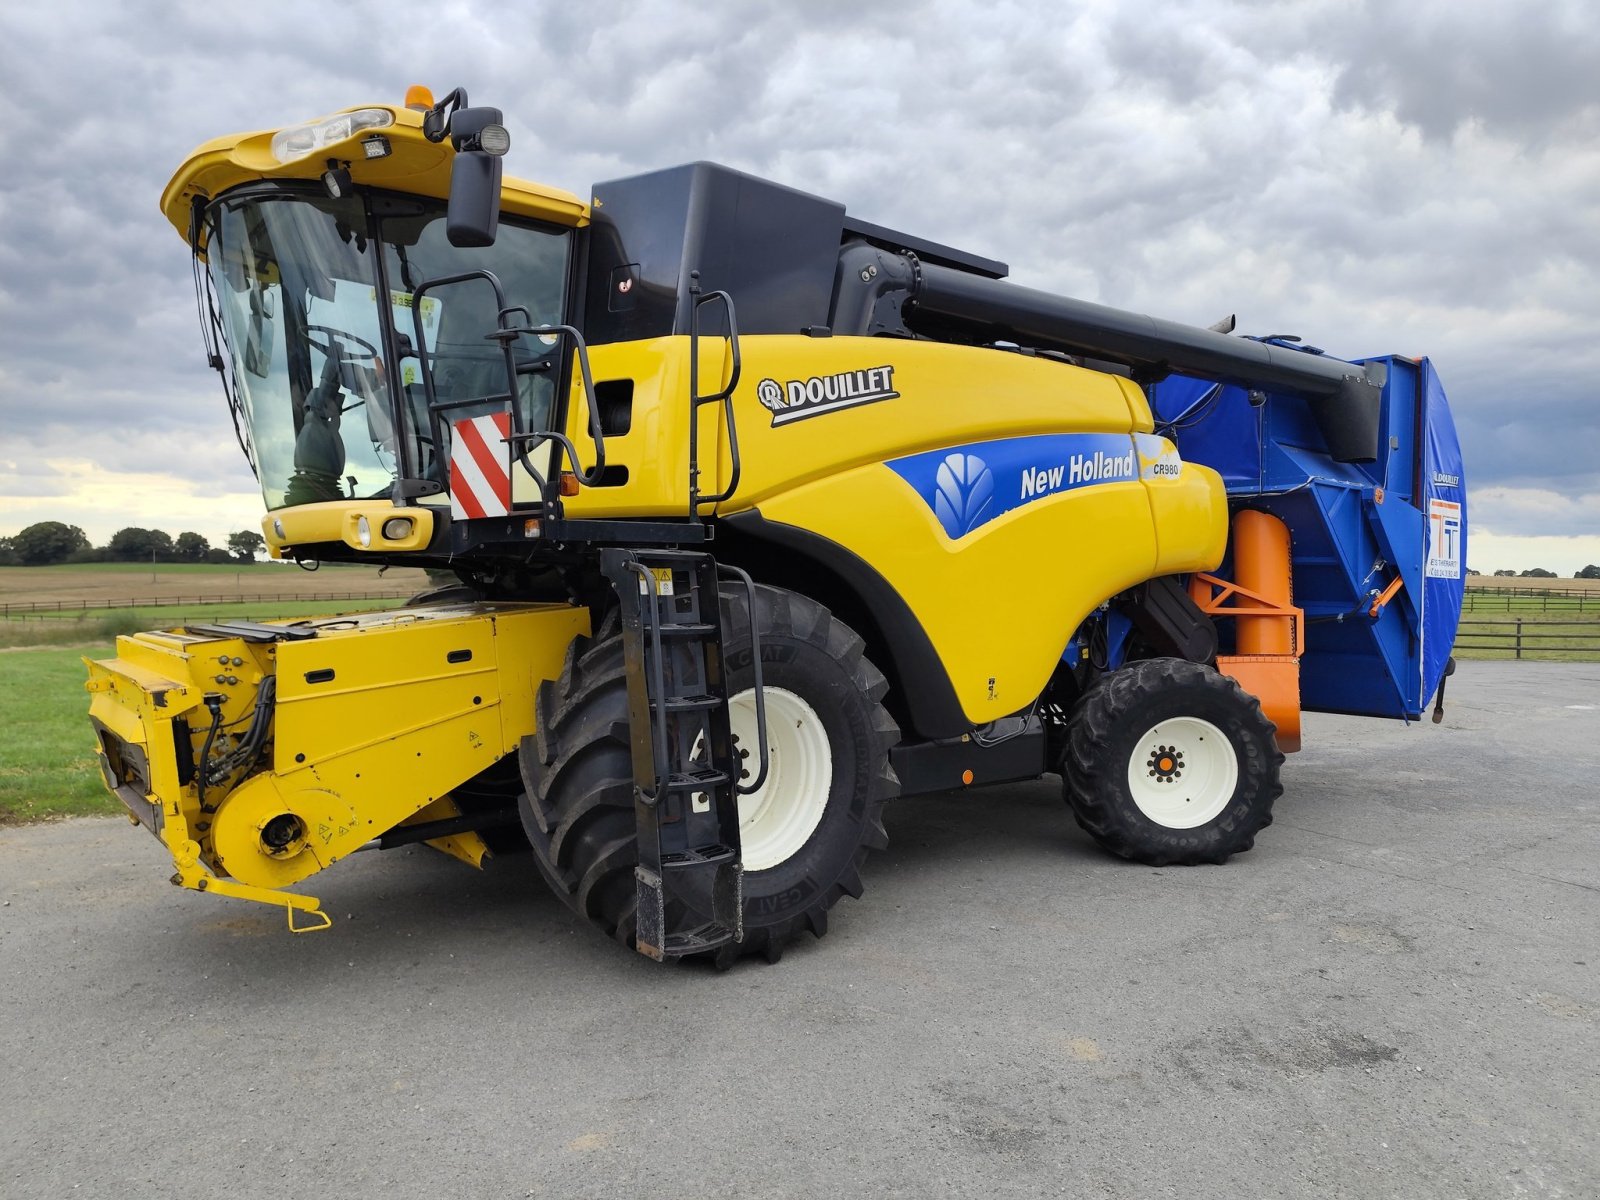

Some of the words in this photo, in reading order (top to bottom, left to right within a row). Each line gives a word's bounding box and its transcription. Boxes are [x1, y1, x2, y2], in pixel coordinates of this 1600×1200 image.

[786, 366, 894, 407] DOUILLET
[1021, 464, 1063, 499] New
[1068, 450, 1133, 483] Holland
[1153, 463, 1179, 475] CR980
[738, 645, 785, 666] CAT
[758, 888, 801, 913] CEAT
